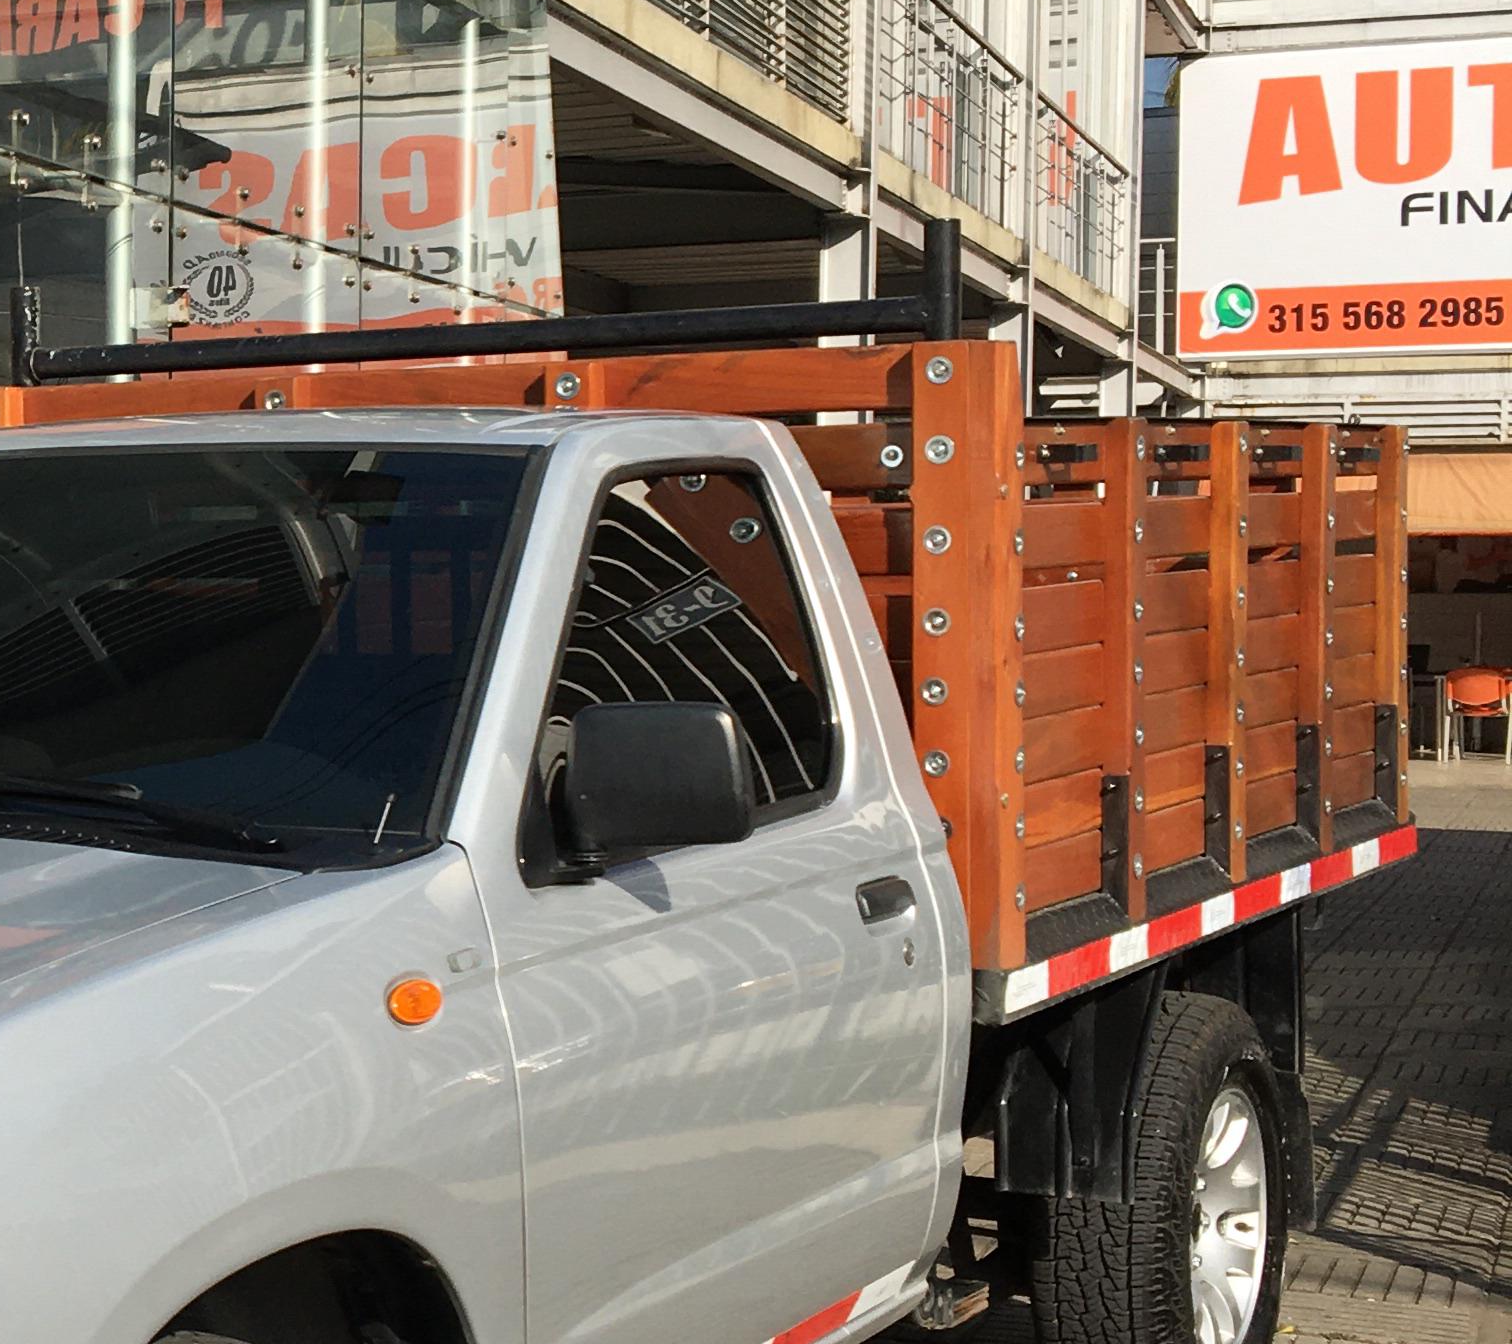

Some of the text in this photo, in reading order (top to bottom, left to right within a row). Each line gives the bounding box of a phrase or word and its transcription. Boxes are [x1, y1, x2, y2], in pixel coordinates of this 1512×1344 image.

[1267, 296, 1505, 334] 315 568 2985
